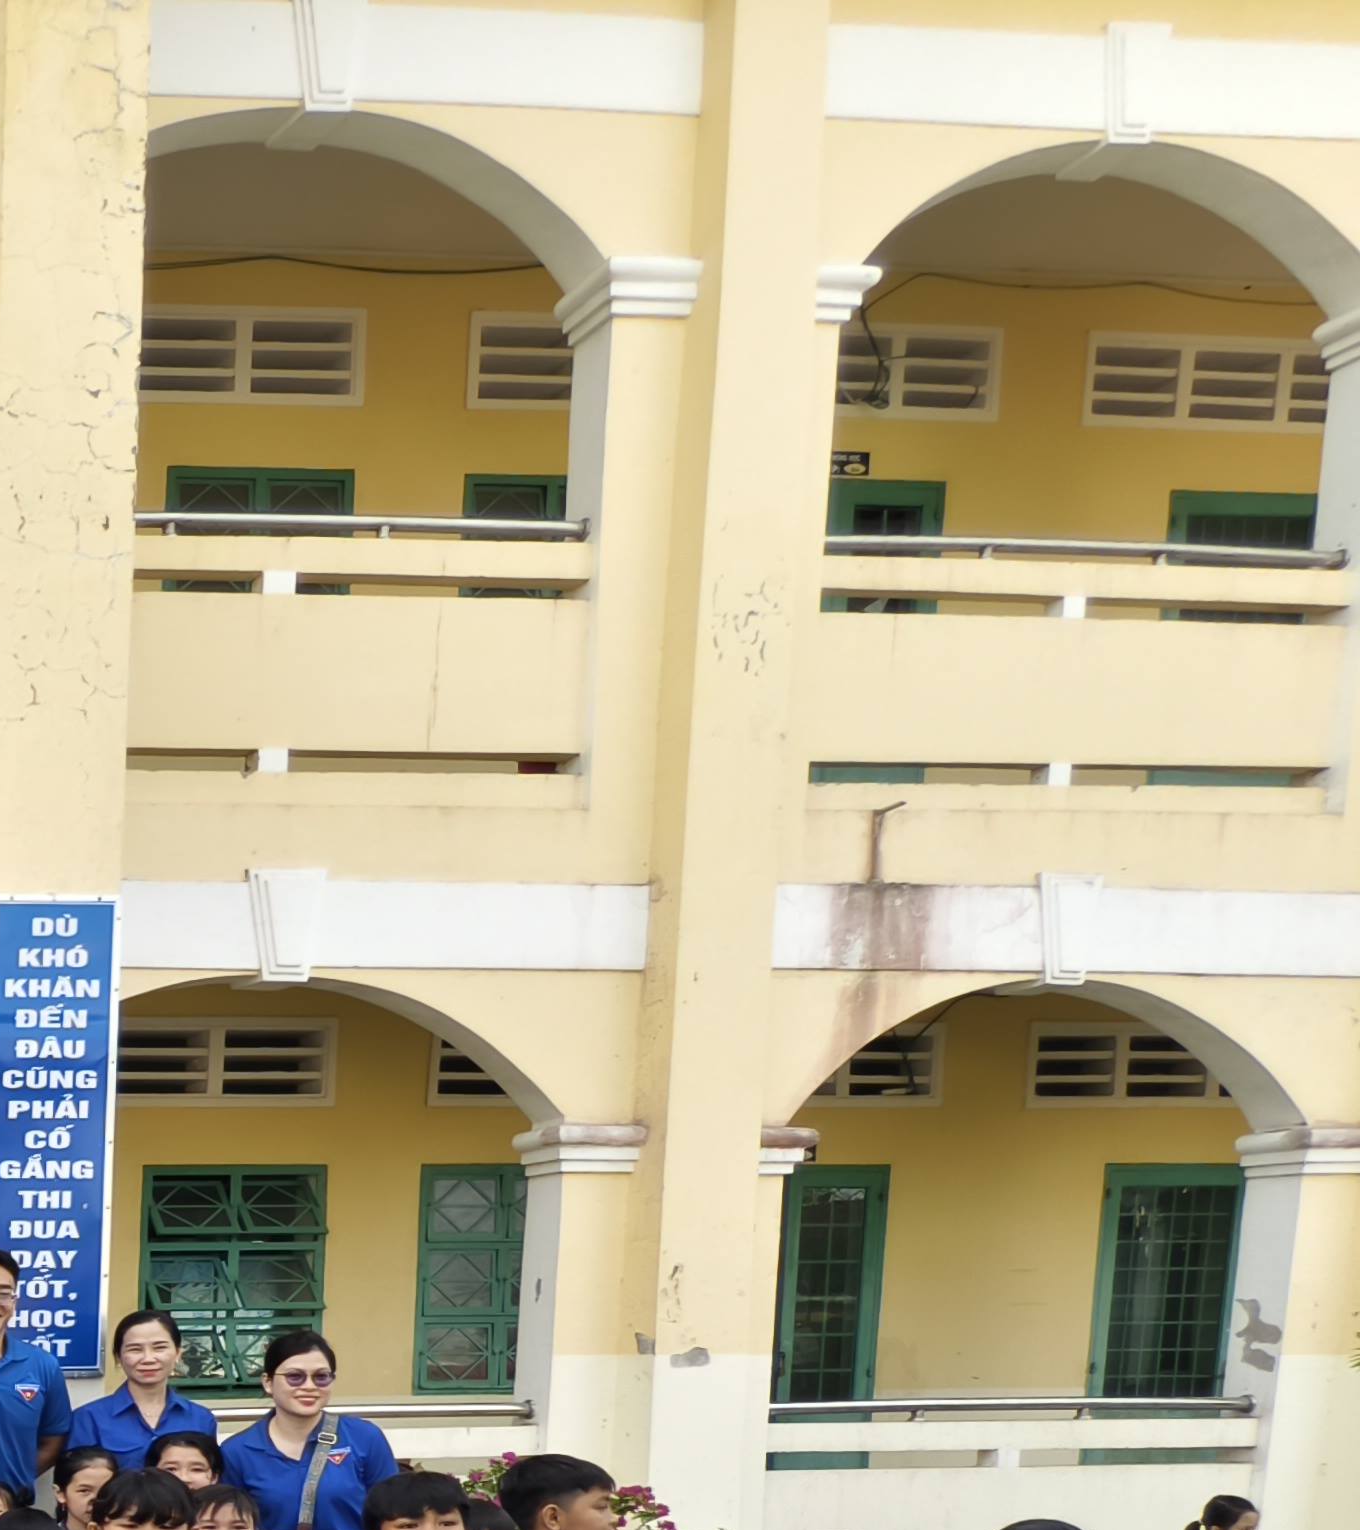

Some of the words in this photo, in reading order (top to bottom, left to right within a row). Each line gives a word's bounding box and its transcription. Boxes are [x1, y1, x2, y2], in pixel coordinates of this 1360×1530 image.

[31, 914, 78, 937] DÙ
[18, 945, 89, 968] KHÓ
[4, 976, 100, 998] KHĂN
[15, 1003, 88, 1029] ĐẾN
[15, 1036, 85, 1059] ĐÂU
[2, 1067, 97, 1089] CŨNG
[7, 1094, 89, 1119] PHẢI
[24, 1124, 75, 1149] CỐ
[0, 1154, 95, 1180] GẮNG
[18, 1190, 72, 1210] THI
[9, 1220, 80, 1239] ĐUA
[10, 1250, 78, 1273] DẠY
[7, 1310, 76, 1332] HỌC
